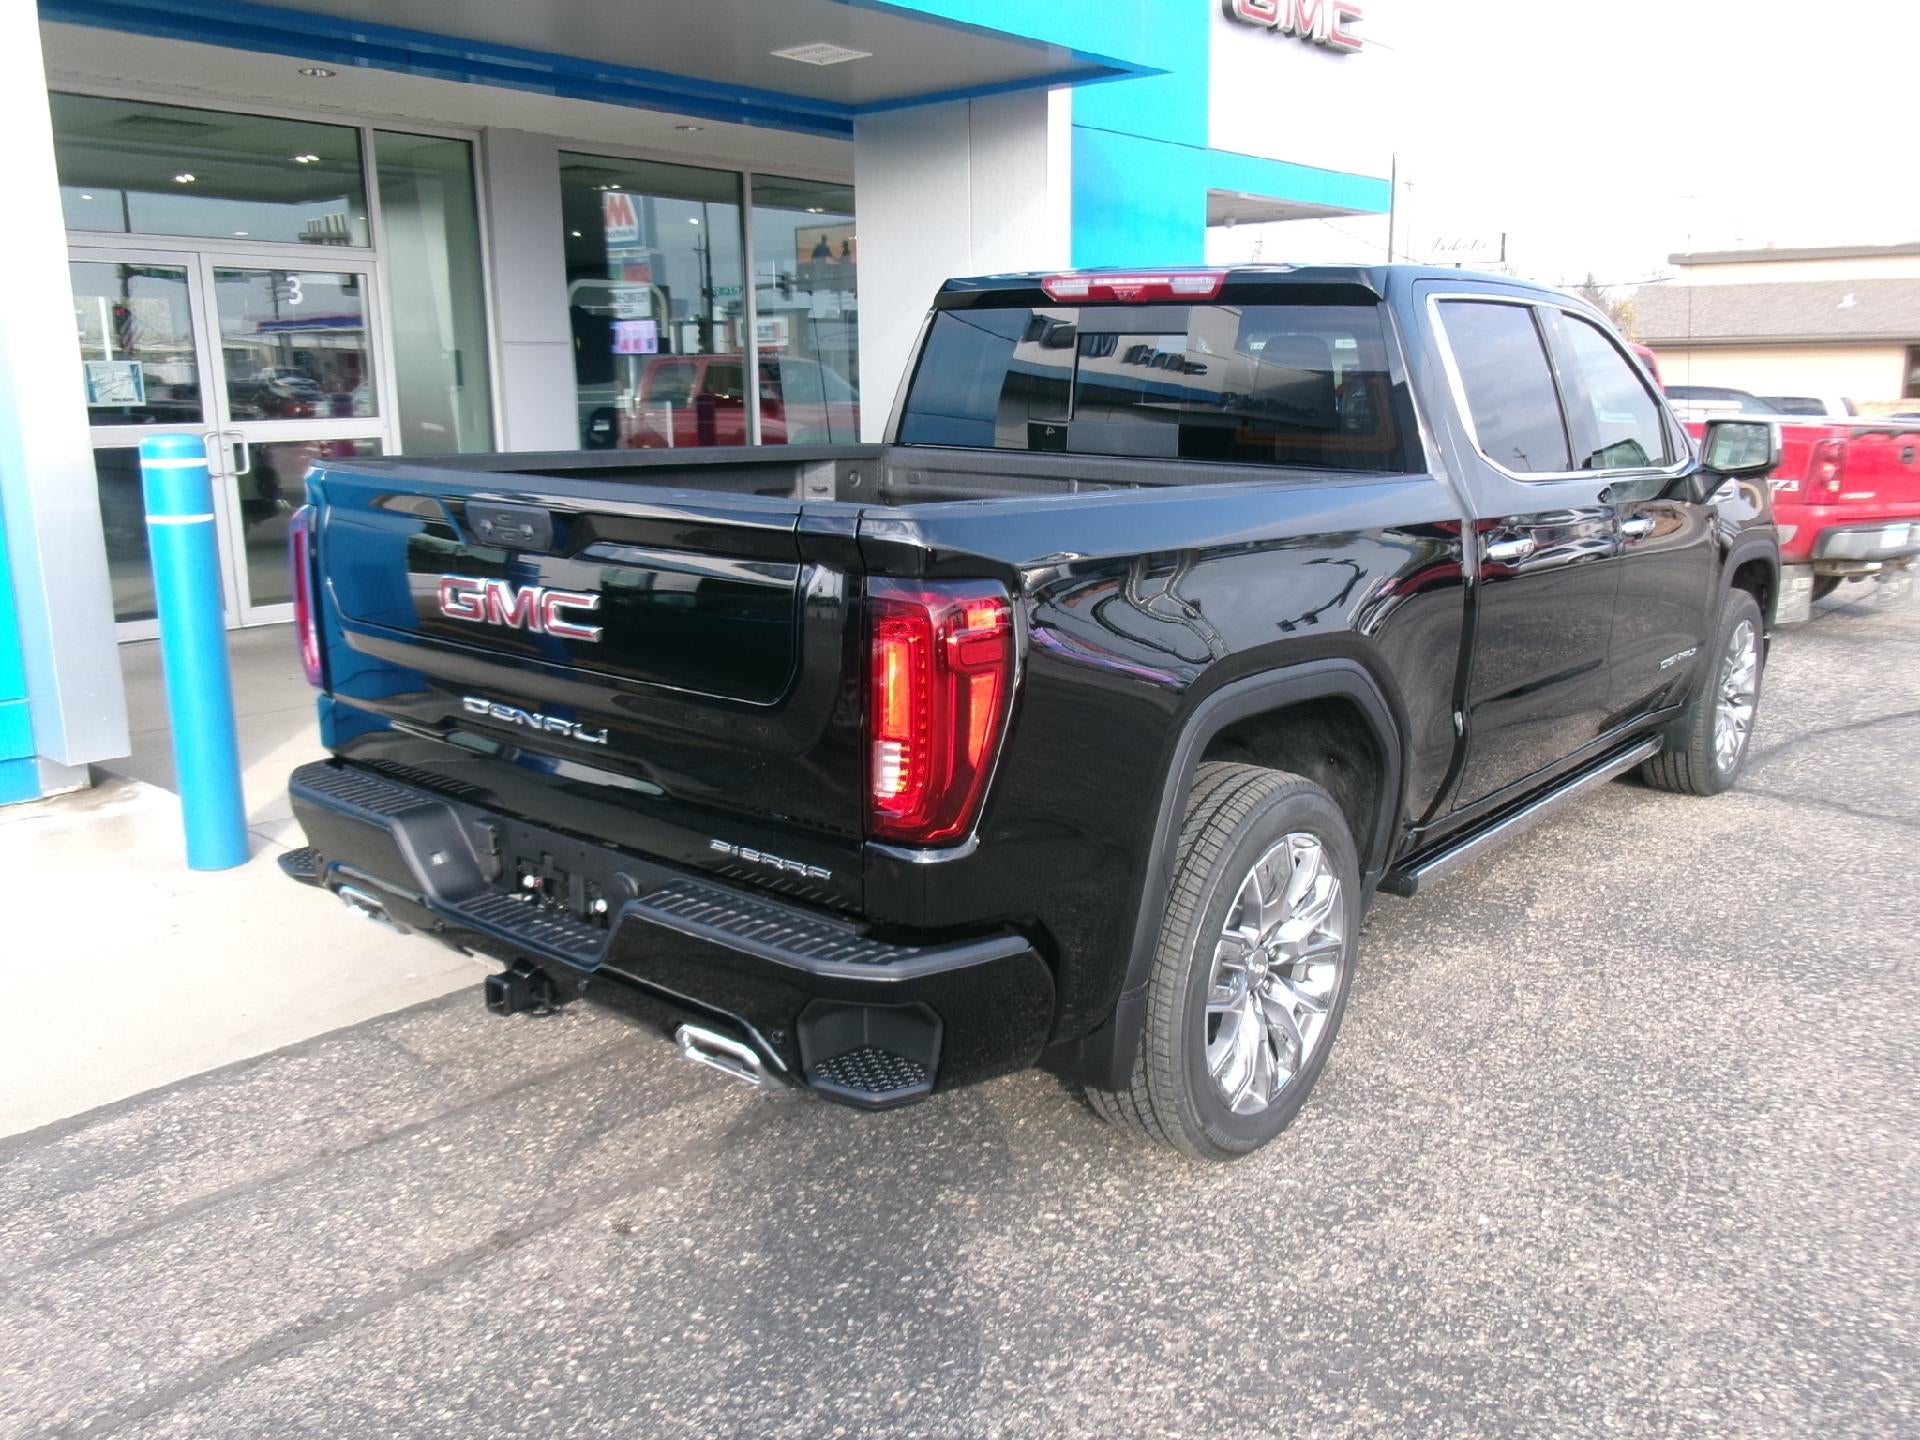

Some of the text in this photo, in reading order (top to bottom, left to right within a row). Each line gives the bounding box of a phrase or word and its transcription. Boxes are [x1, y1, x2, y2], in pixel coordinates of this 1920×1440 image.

[286, 276, 303, 305] 3
[438, 574, 603, 642] GMC
[463, 697, 609, 745] DENALI
[710, 839, 832, 880] SIERRA
